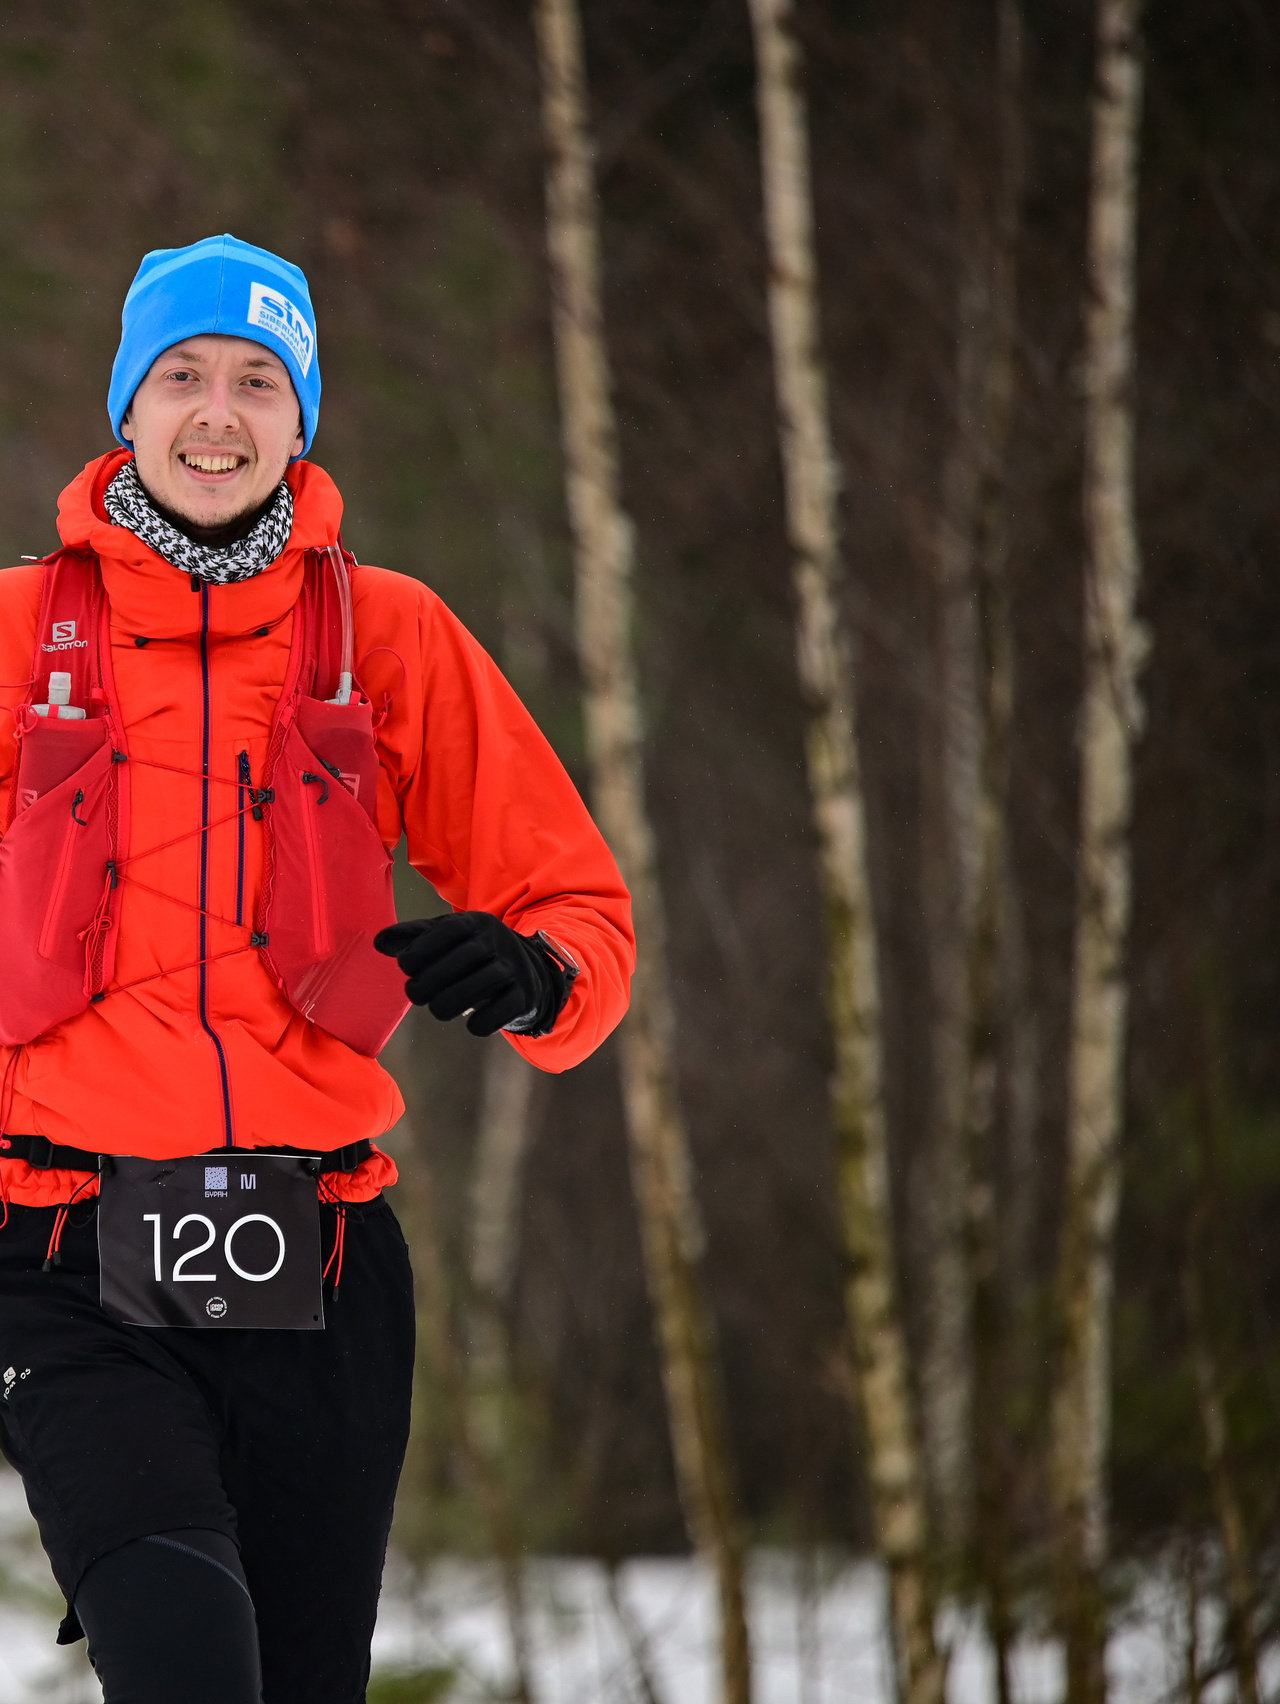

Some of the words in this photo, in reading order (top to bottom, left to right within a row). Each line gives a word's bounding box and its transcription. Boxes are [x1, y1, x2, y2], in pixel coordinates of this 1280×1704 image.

[258, 319, 279, 332] HALF
[259, 311, 300, 347] SIBERIAN
[241, 1174, 256, 1190] M
[143, 1214, 286, 1282] 120
[3, 1368, 31, 1400] OMOS
